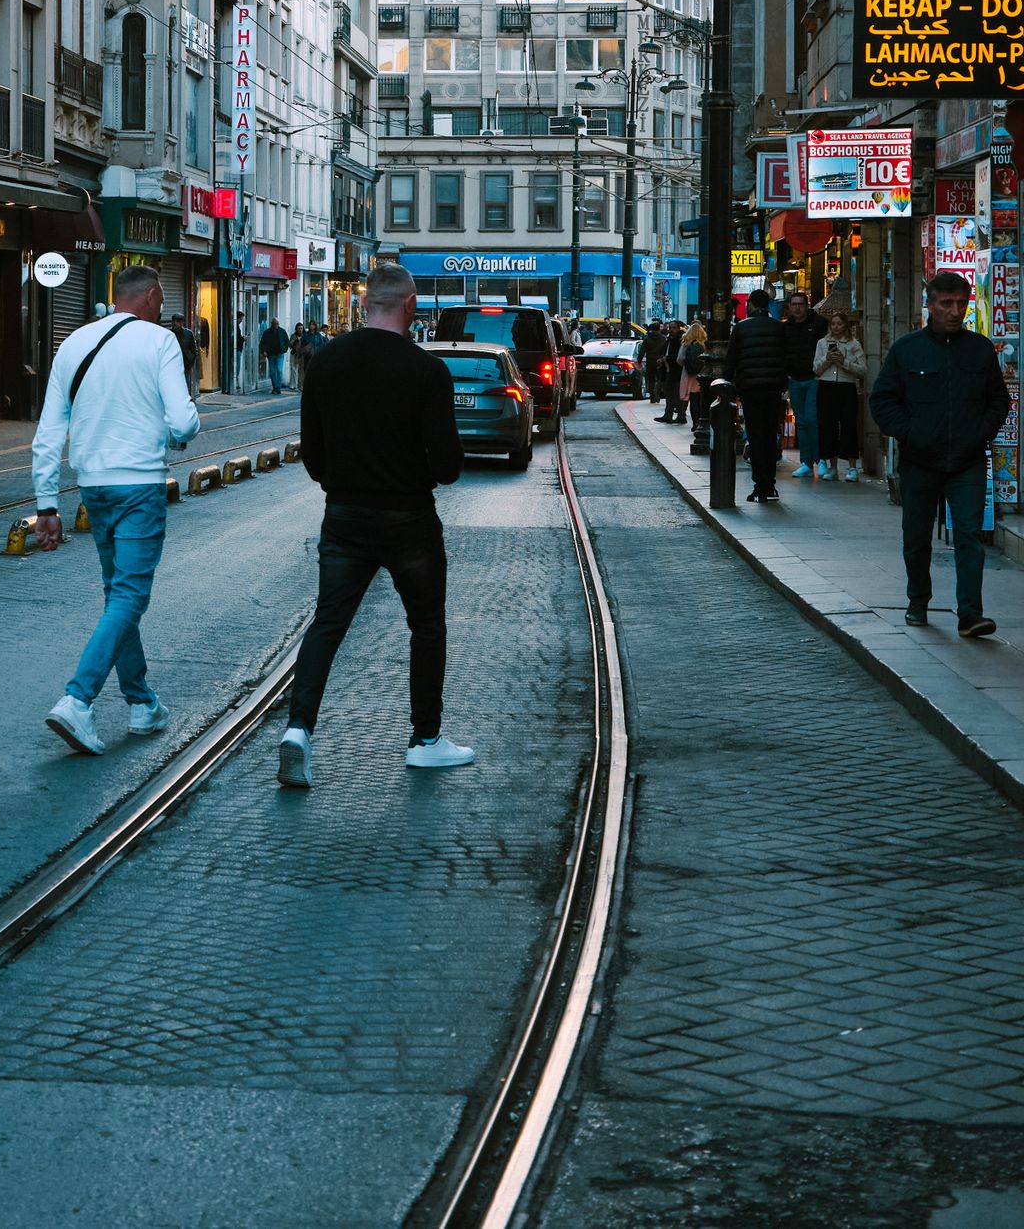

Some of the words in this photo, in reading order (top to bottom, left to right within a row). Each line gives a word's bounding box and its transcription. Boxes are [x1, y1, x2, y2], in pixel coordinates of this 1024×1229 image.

[868, 18, 950, 40] كباب
[236, 8, 251, 171] PHARMACY
[809, 146, 874, 157] BOSPHORUS
[876, 145, 911, 155] TOURS
[867, 161, 910, 183] 10€
[809, 201, 875, 210] CAPPADOCIA
[75, 240, 93, 250] NEA
[476, 256, 536, 272] YapıKredi
[994, 266, 1005, 336] HAMAM
